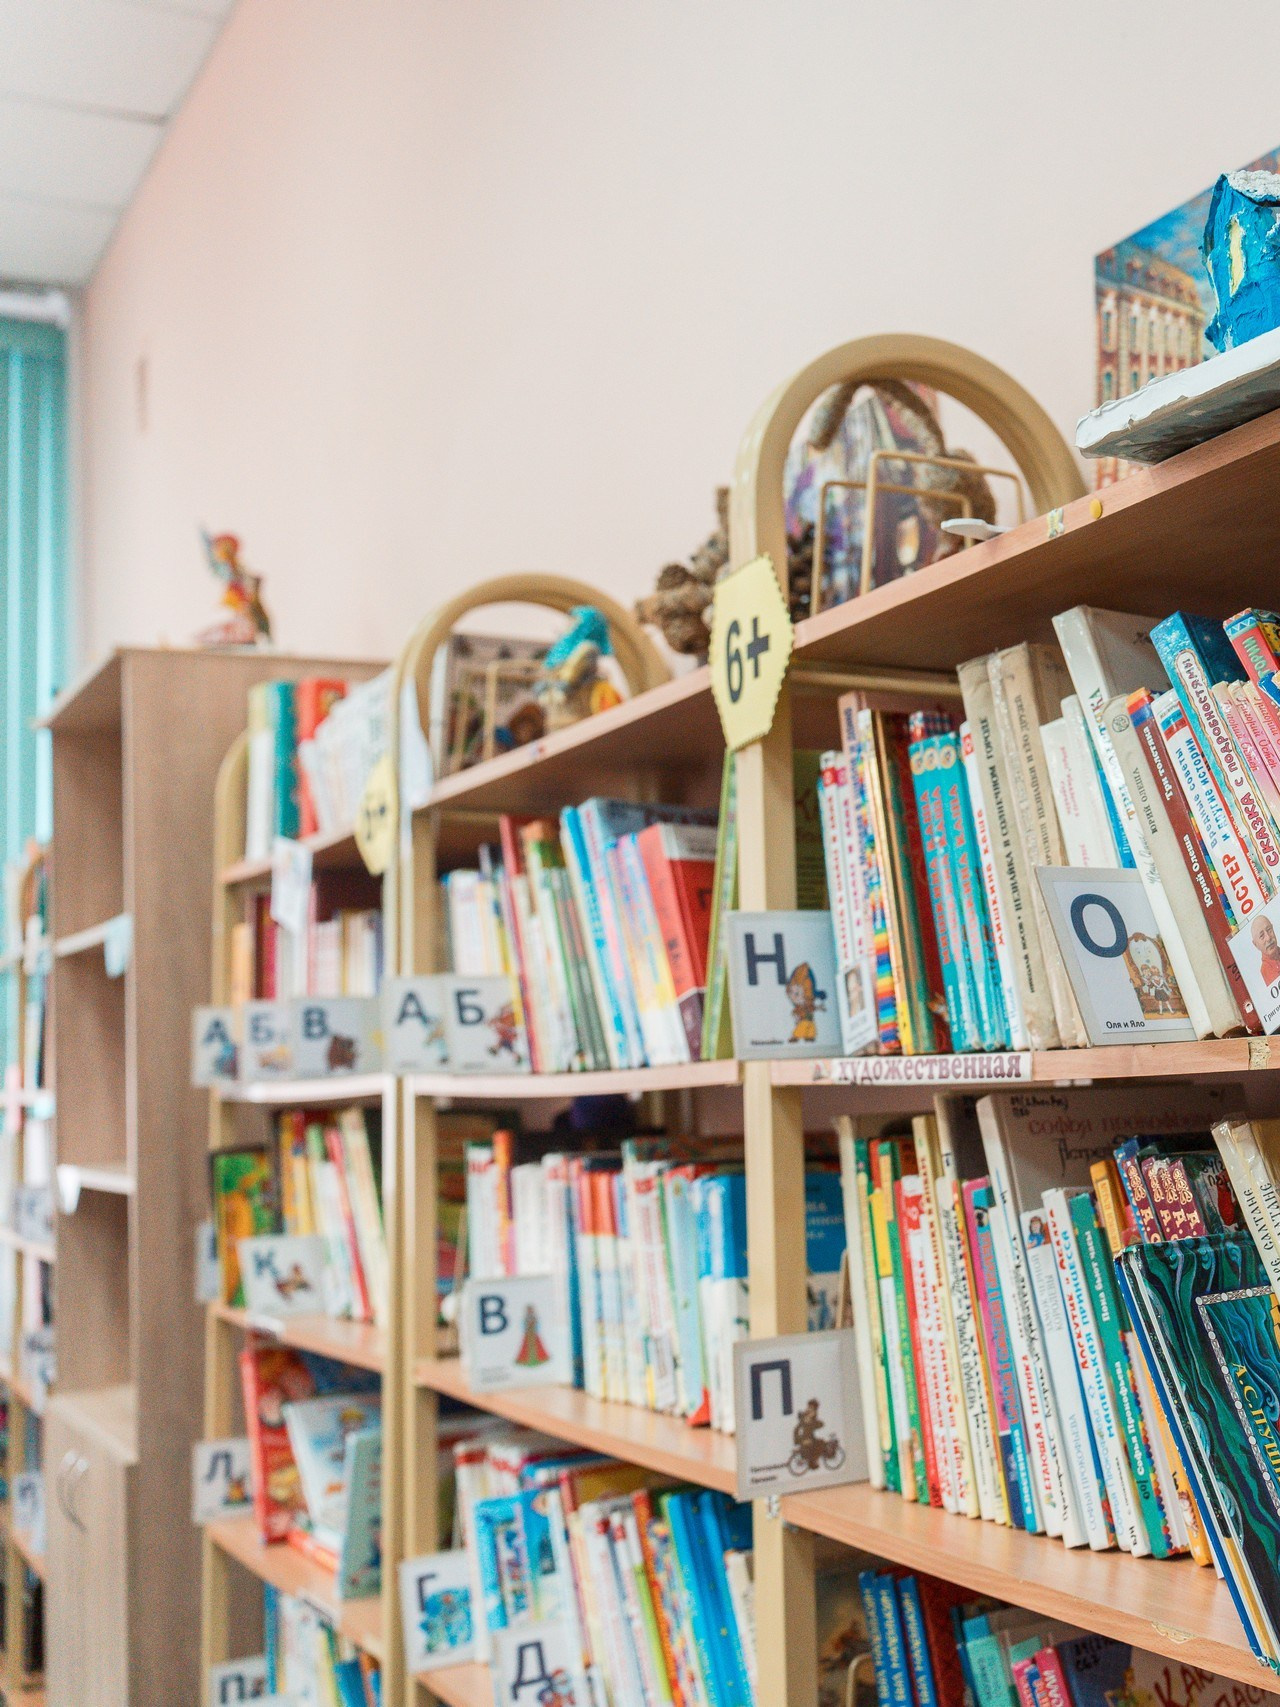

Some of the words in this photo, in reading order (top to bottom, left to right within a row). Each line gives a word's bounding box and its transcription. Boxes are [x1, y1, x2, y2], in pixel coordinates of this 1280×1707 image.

[725, 617, 771, 703] 6+
[1180, 657, 1241, 774] ПОДРОБНОСТЯМИ
[978, 716, 996, 761] ГОРОДЕ
[1143, 725, 1167, 780] толстяка
[1132, 766, 1149, 805] ОЛЕША
[1177, 747, 1196, 792] советы
[1185, 737, 1212, 791] истории
[989, 763, 1010, 838] СОЛНЕЧНОМ
[1160, 779, 1174, 801] Три
[919, 789, 935, 853] КАША
[948, 784, 966, 848] КАША
[1142, 806, 1158, 836] ЮРИЙ
[1239, 791, 1279, 868] СКАЗКА
[1183, 833, 1201, 874] Олеша
[1201, 877, 1215, 909] Юрий
[1221, 852, 1255, 915] ОСТЕР
[928, 856, 950, 965] МИШКИНА
[1069, 893, 1129, 959] О
[744, 932, 787, 986] Н
[202, 1014, 231, 1045] А
[249, 1012, 276, 1043] Б
[302, 1006, 331, 1041] В
[393, 989, 432, 1027] А
[455, 988, 487, 1028] Б
[1105, 1020, 1122, 1030] Оля
[1129, 1019, 1146, 1029] Яло
[838, 1053, 1023, 1087] художественная
[1242, 1187, 1275, 1251] САЛТАНЕ
[252, 1248, 280, 1281] К
[1083, 1228, 1098, 1263] часы
[1060, 1229, 1091, 1326] ПРИНЦЕССА
[1093, 1263, 1106, 1296] бьют
[478, 1294, 510, 1337] В
[1063, 1290, 1090, 1370] ЛОСКУТИК
[1100, 1296, 1112, 1323] Пока
[751, 1359, 793, 1420] П
[1085, 1328, 1115, 1439] МАЛЕНЬКАЯ
[1112, 1360, 1143, 1445] Прокофьева
[1068, 1412, 1091, 1485] ПРОКОФЬЕВА
[1134, 1442, 1148, 1479] Софья
[1081, 1485, 1097, 1531] СОФЬЯ
[415, 1571, 439, 1615] Г
[512, 1640, 552, 1702] Д
